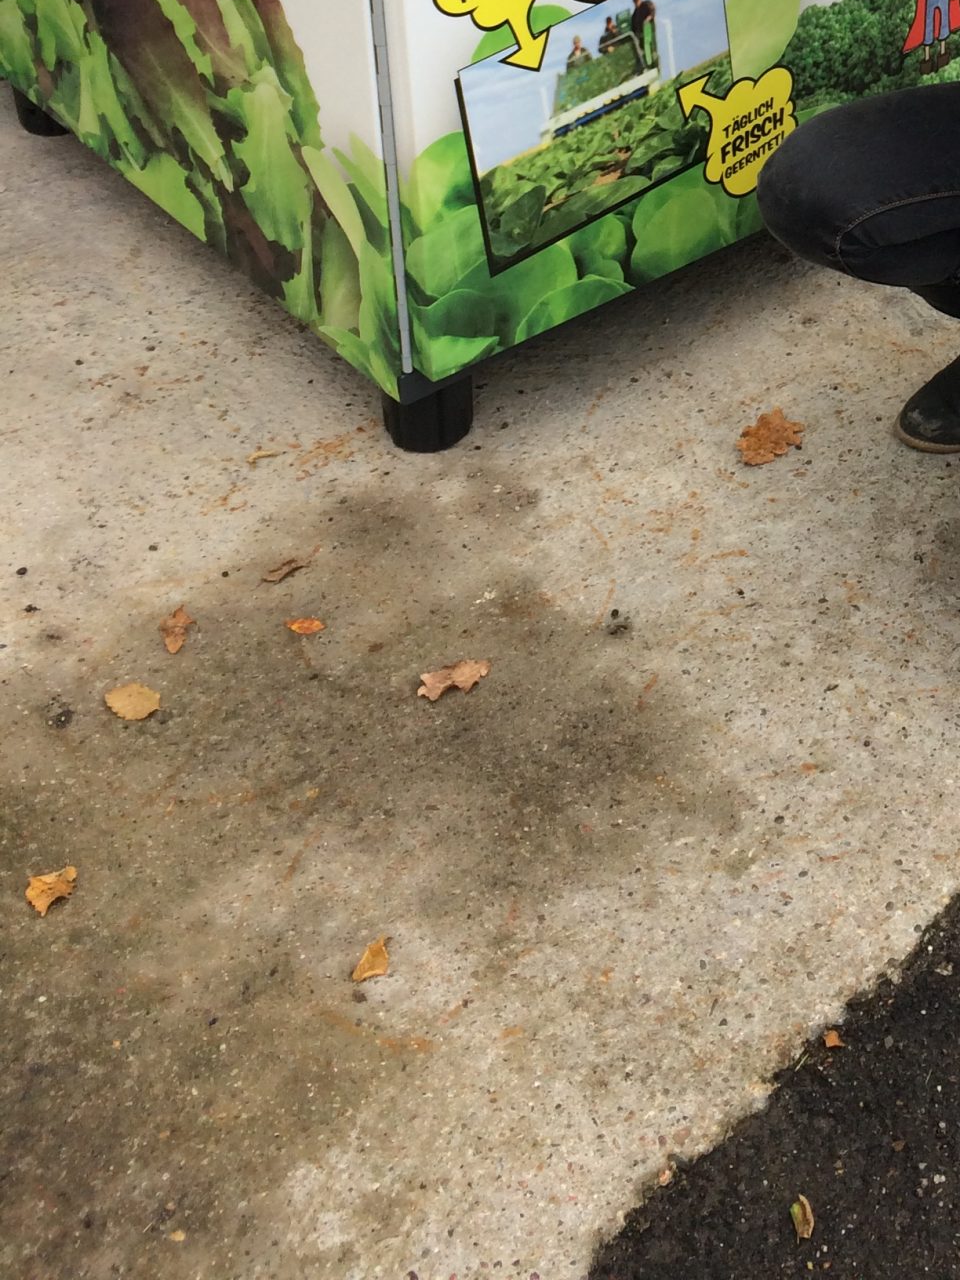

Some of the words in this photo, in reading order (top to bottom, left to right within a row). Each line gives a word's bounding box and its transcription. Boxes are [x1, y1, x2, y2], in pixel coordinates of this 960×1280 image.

[720, 107, 784, 164] FRISCH
[723, 97, 774, 139] TÄGLICH
[724, 130, 785, 179] GEERNTET!
